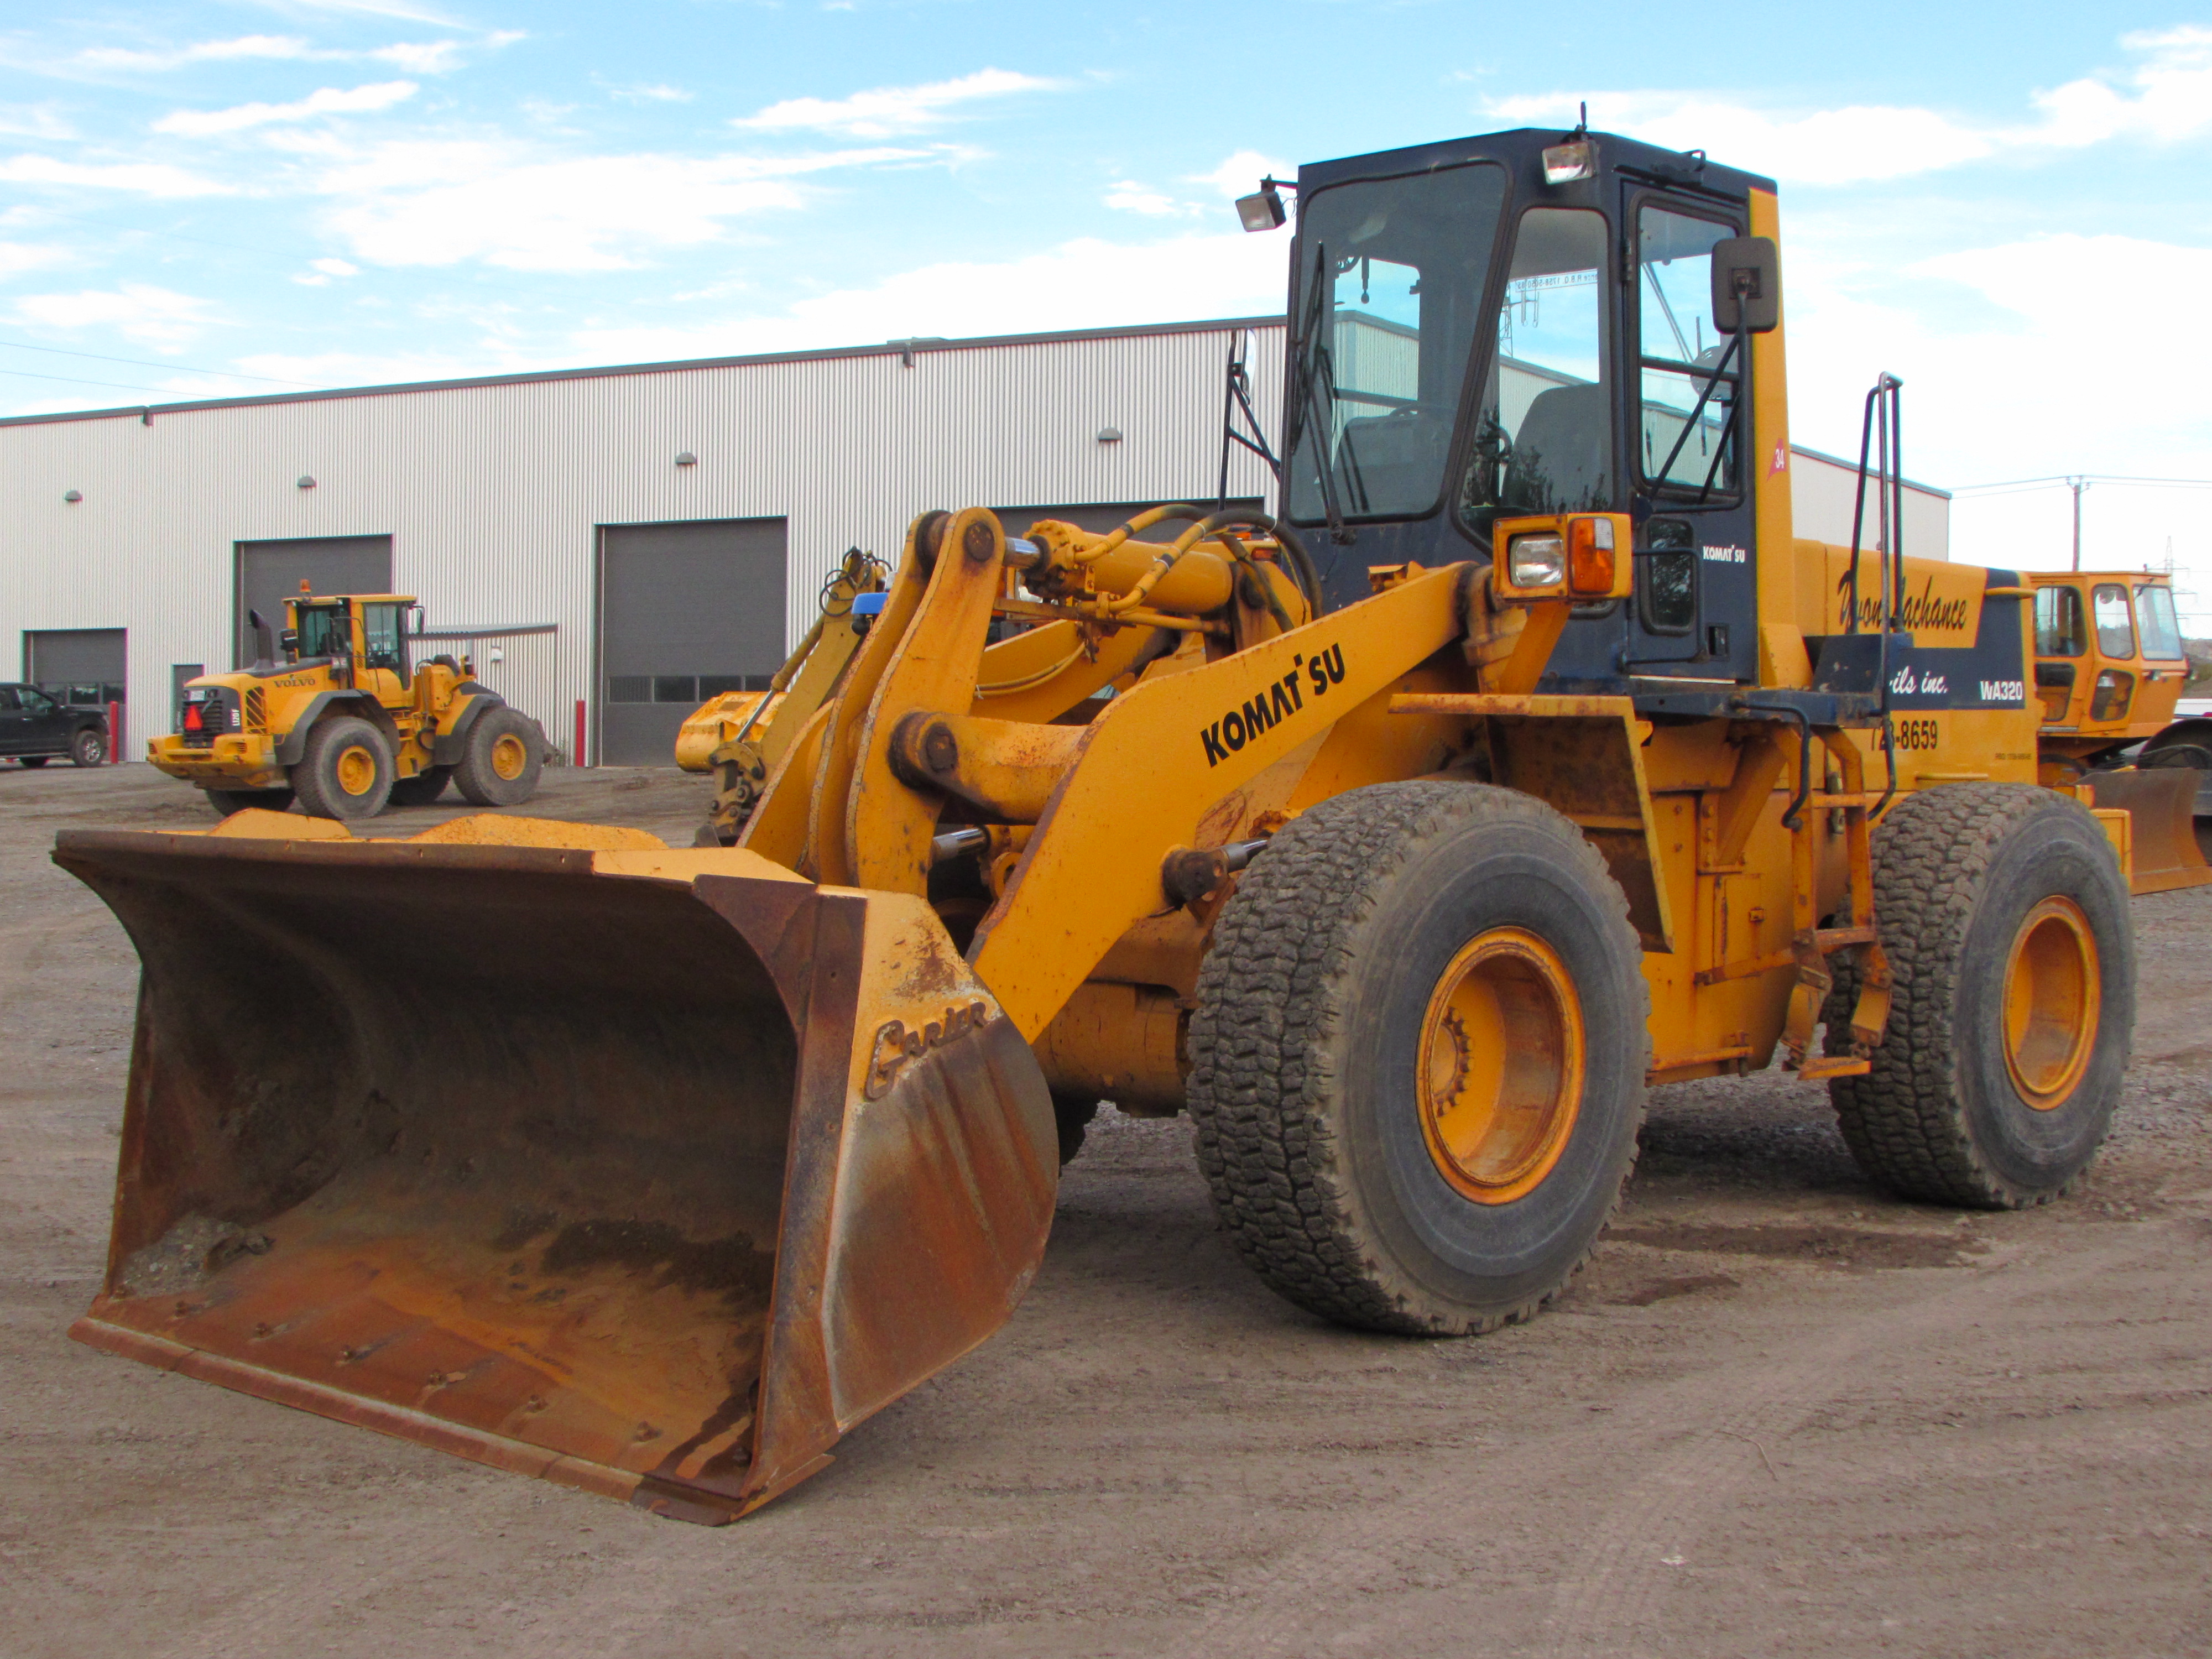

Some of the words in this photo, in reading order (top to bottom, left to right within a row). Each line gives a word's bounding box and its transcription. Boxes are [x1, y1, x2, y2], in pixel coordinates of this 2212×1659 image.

[1775, 448, 1785, 469] 34
[1703, 544, 1746, 563] KOMATSU
[1901, 575, 1966, 630] achance
[274, 679, 315, 687] VOLVO
[1889, 665, 1917, 694] ils
[1921, 670, 1948, 694] inc.
[1980, 681, 2024, 700] WA320
[1201, 643, 1345, 768] KOMATSU
